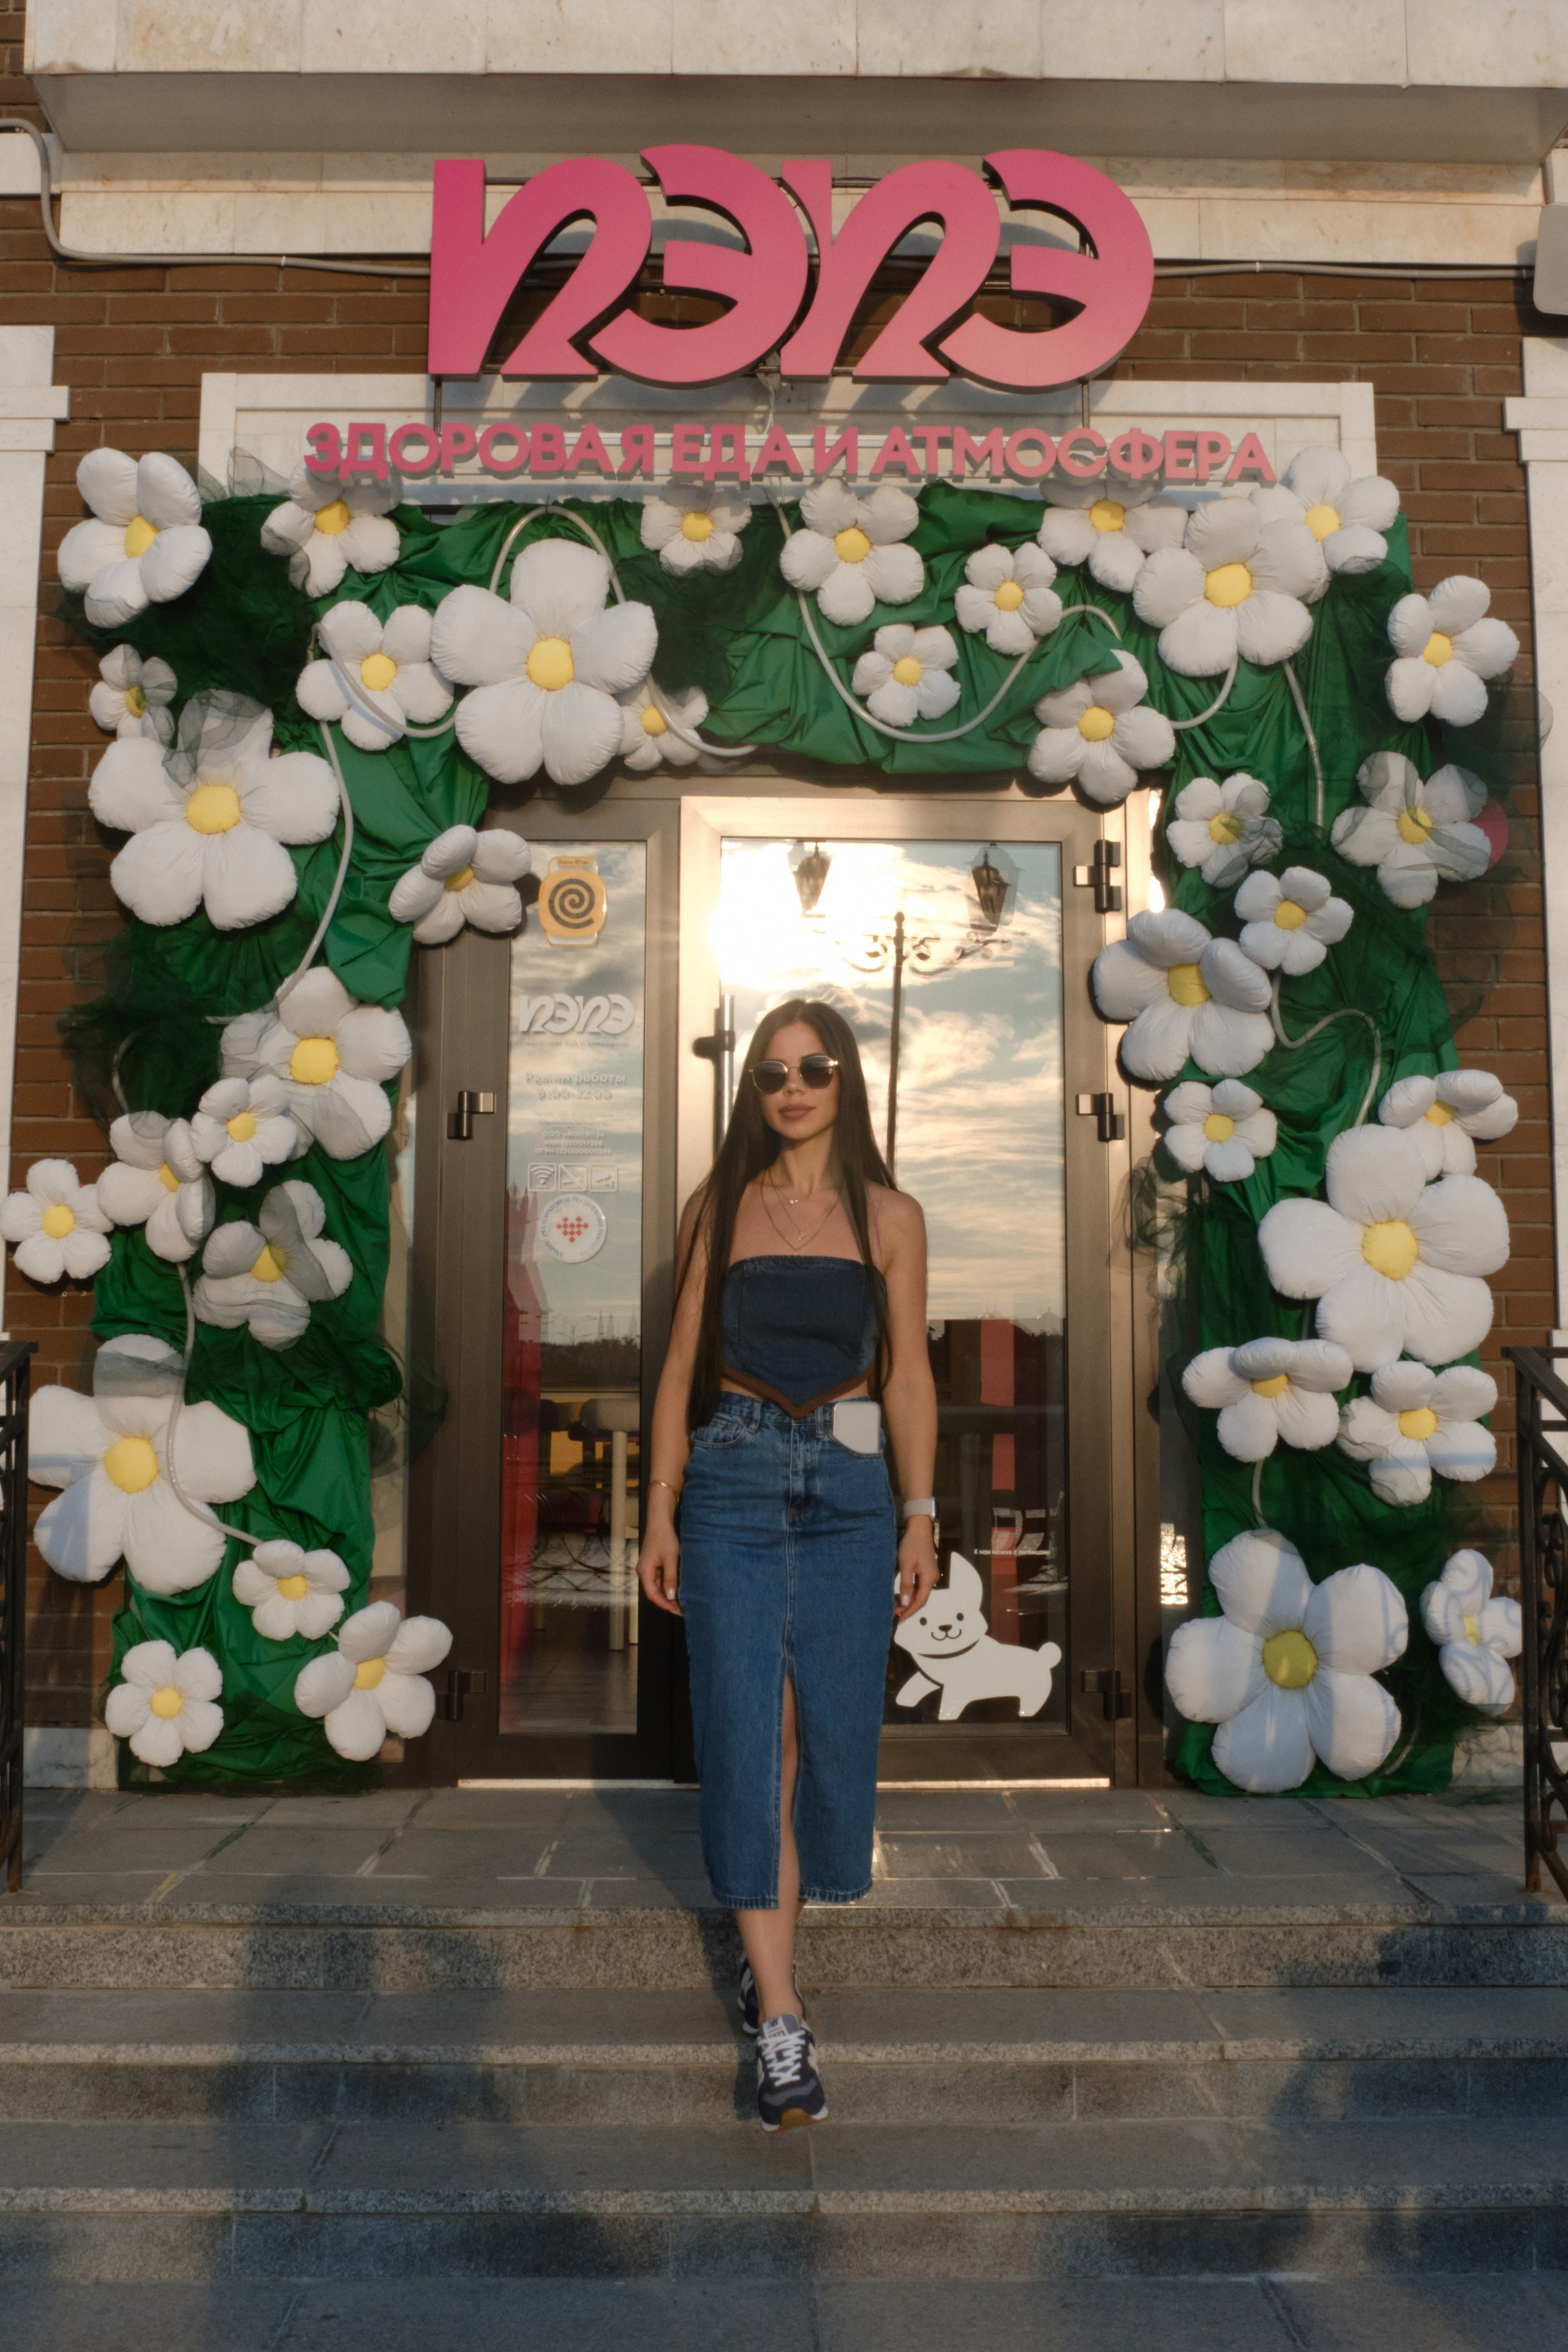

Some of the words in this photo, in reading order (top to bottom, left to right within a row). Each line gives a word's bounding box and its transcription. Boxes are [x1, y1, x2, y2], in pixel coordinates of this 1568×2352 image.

[304, 423, 655, 480] ЗДОРОВАЯ
[672, 424, 804, 482] ЕДА
[813, 425, 858, 477] И
[869, 425, 1277, 481] АТМОСФЕРА
[575, 1072, 626, 1086] работы
